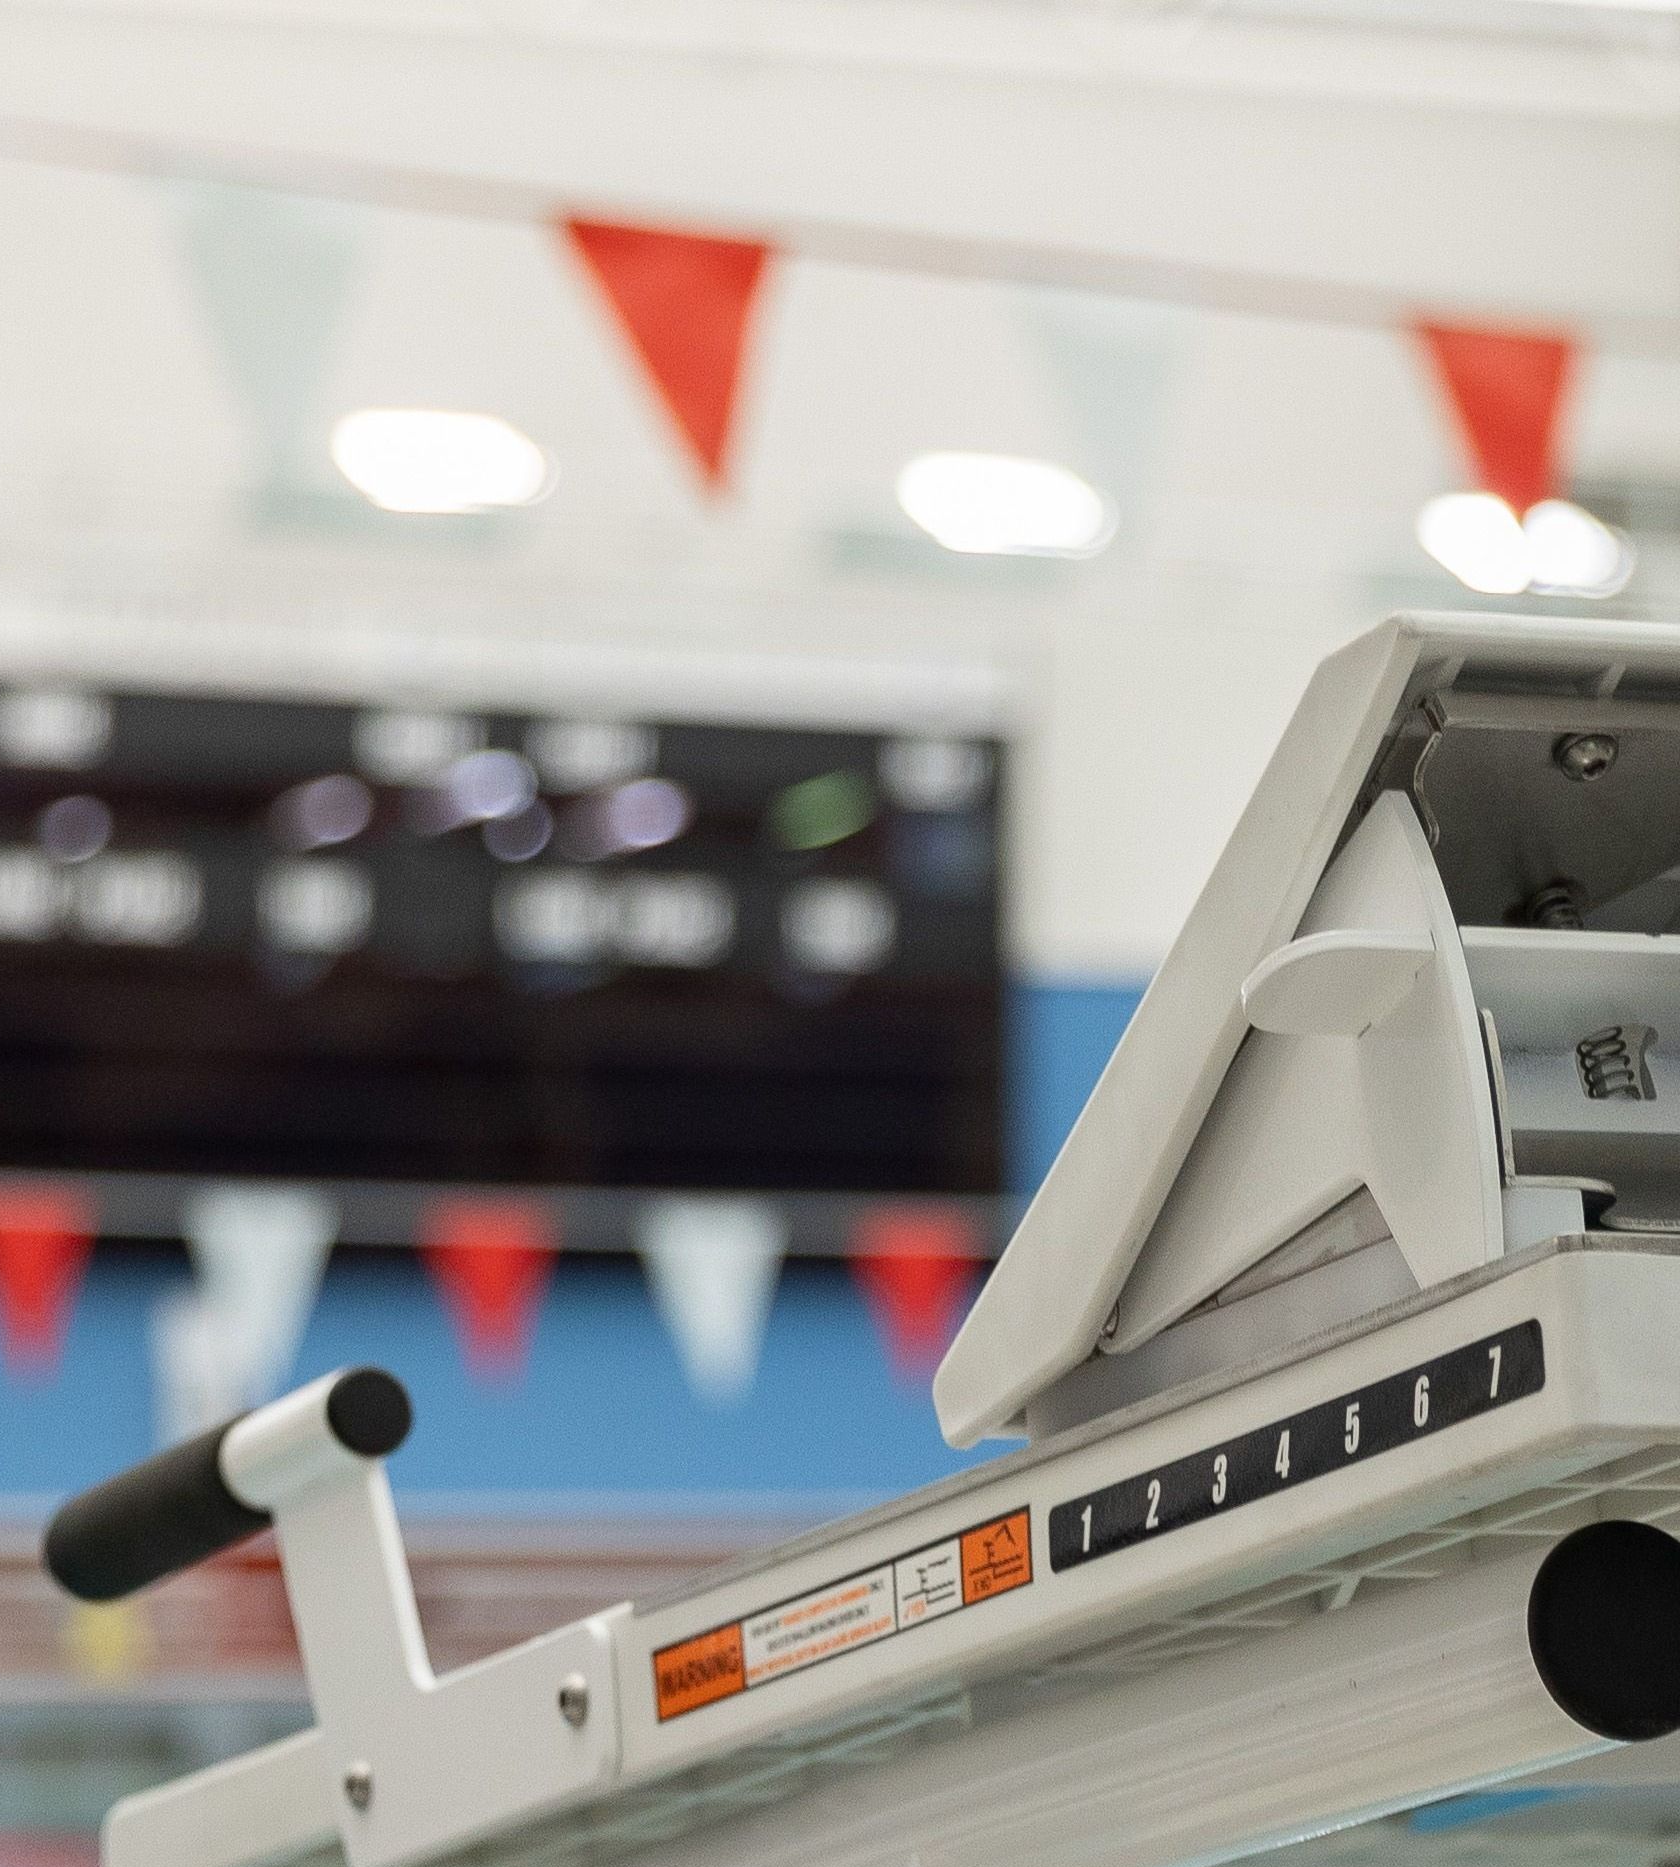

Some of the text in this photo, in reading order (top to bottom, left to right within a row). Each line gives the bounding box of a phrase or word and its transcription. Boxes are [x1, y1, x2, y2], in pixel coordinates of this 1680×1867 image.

[1082, 1346, 1501, 1552] 1 2 3 4 5 6 7
